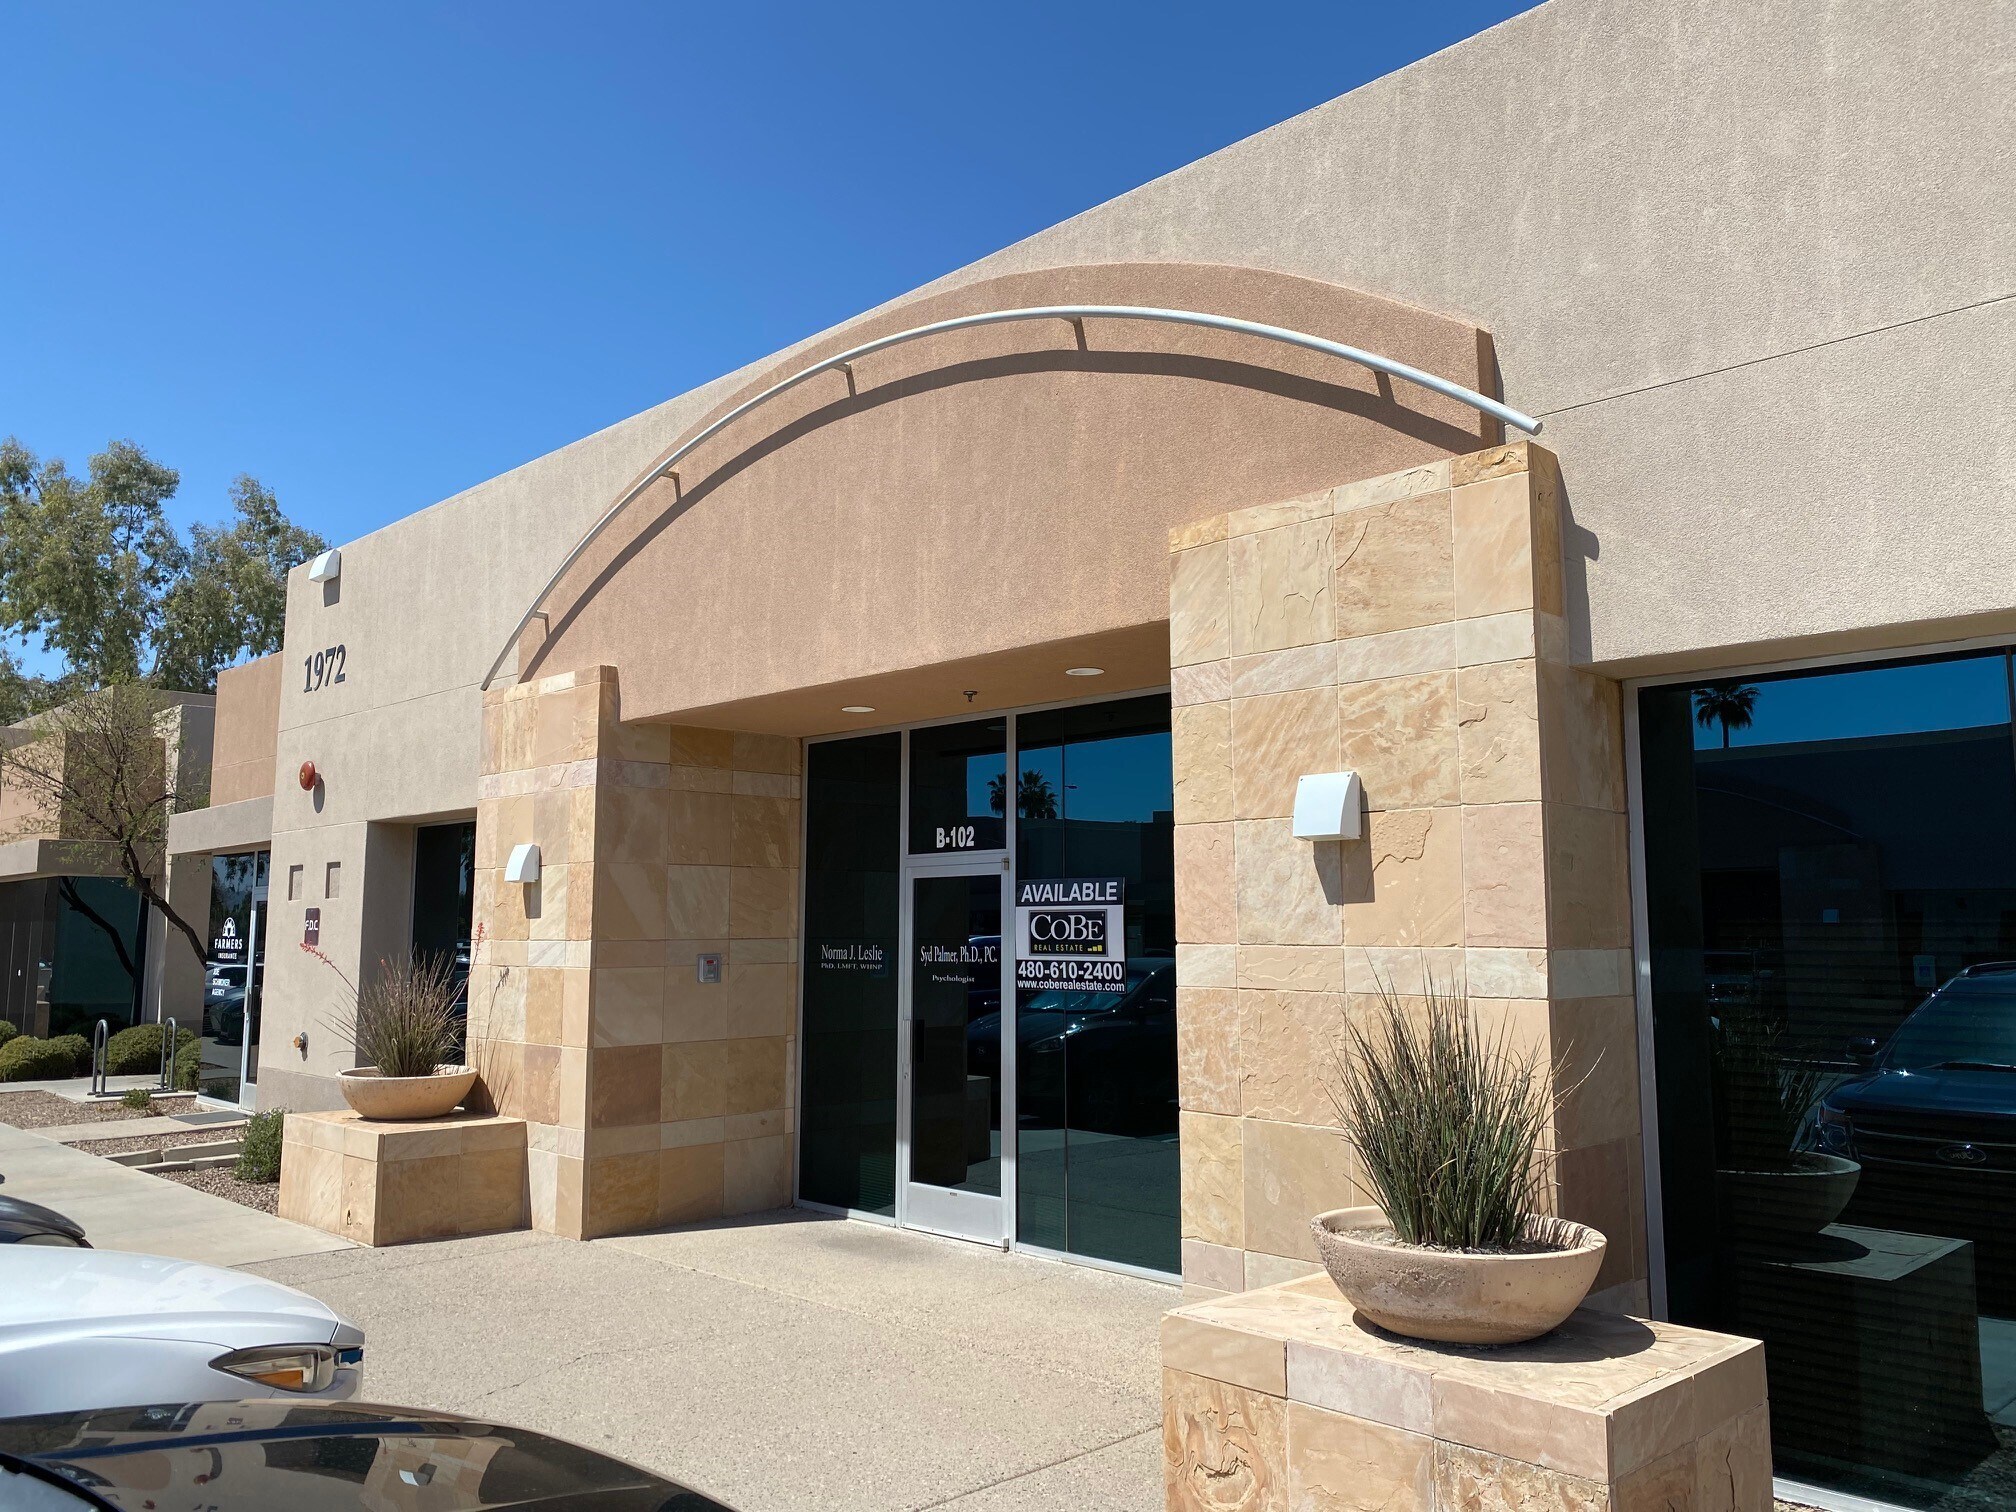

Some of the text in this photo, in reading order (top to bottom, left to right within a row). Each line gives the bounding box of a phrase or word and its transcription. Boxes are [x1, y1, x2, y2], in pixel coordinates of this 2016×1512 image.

[303, 644, 346, 693] 1972
[936, 825, 975, 848] B-102
[1021, 882, 1118, 902] AVAILABLE
[214, 938, 243, 950] FARMERS
[1033, 944, 1083, 952] REAL ESTATE
[217, 952, 237, 960] INSURANCE
[821, 944, 883, 961] Norma J. Leslie
[920, 945, 998, 967] Syd Palmer, Ph.D., PC.
[1018, 961, 1123, 980] 480-610-2400
[932, 974, 975, 984] Psychologist
[1017, 979, 1125, 992] www.coberealestate.com
[211, 988, 225, 996] AGENCY
